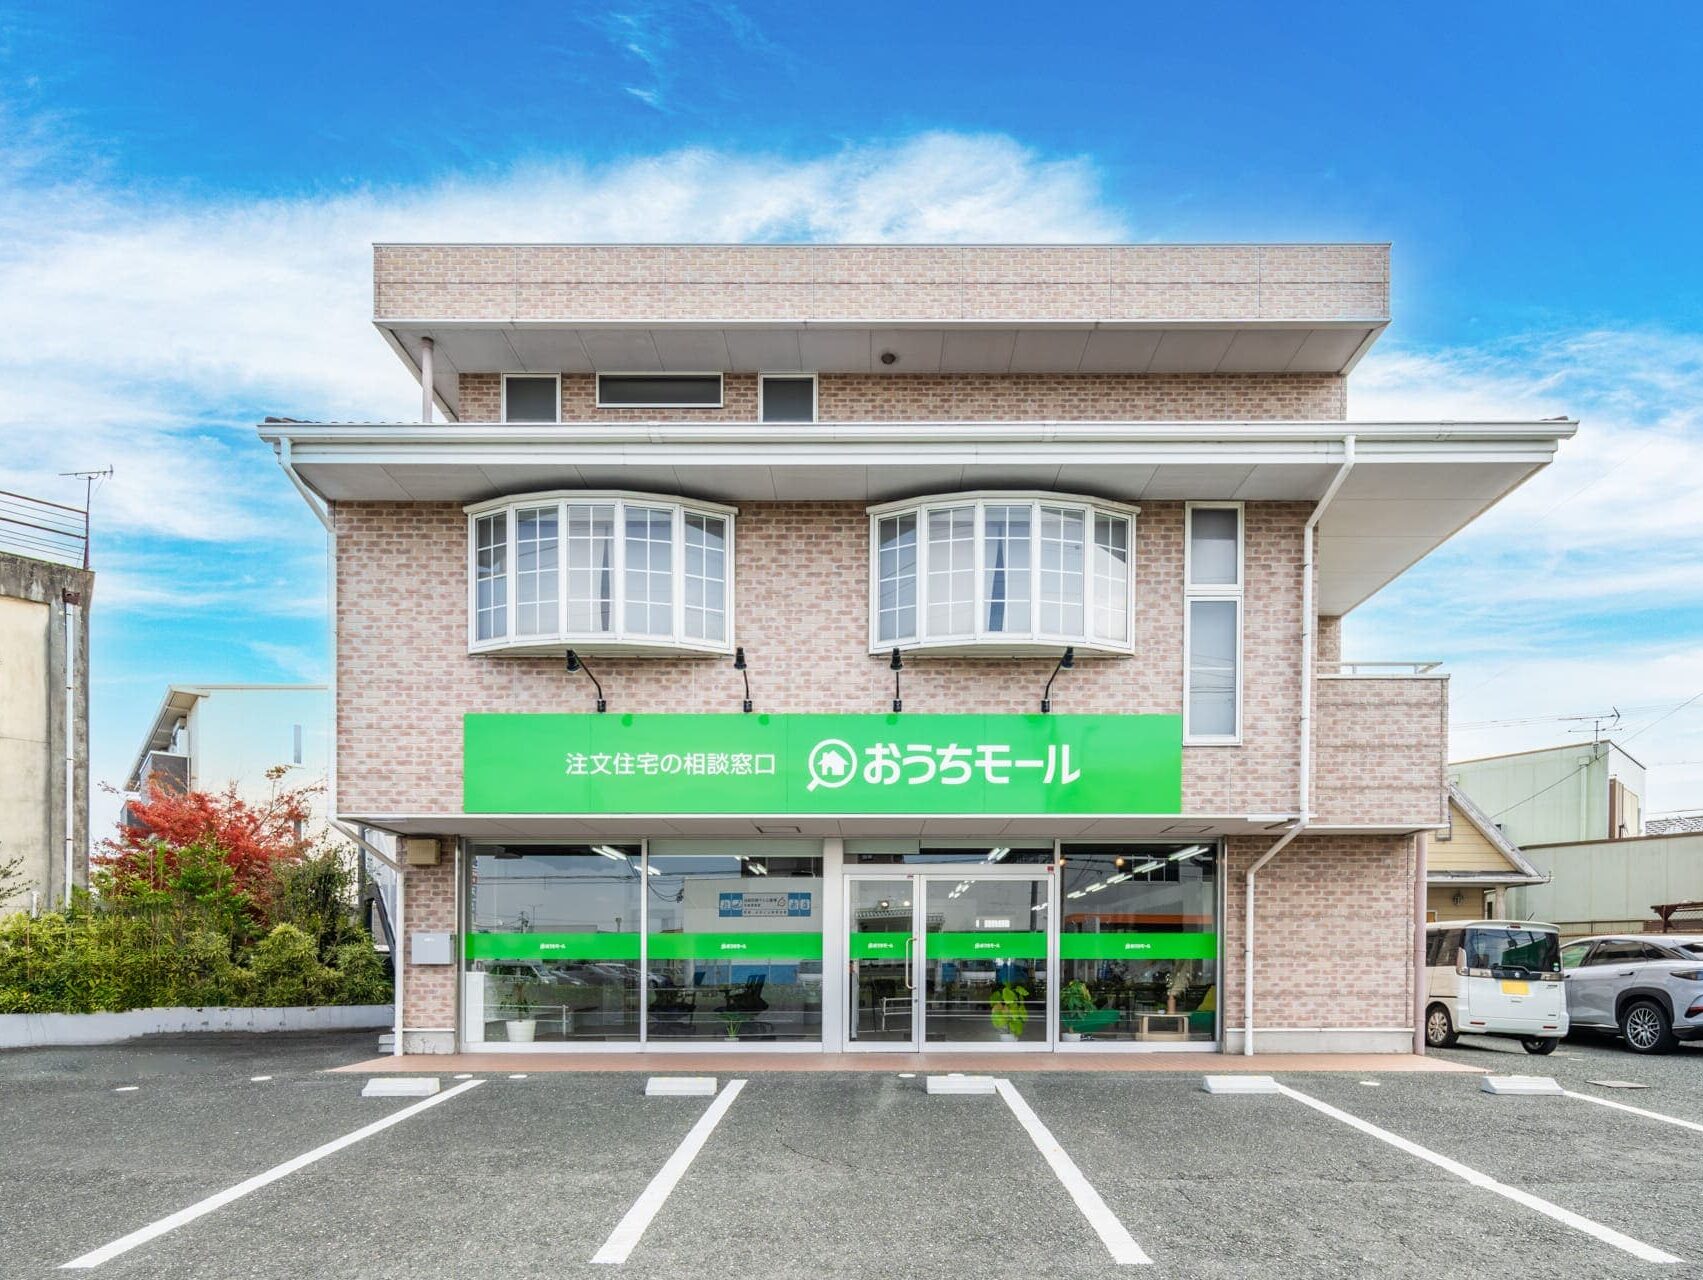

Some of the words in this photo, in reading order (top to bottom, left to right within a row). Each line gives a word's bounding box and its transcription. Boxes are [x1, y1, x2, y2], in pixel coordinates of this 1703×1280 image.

[566, 752, 776, 776] 注文住宅の相談窓口
[863, 742, 1081, 786] おうちモール
